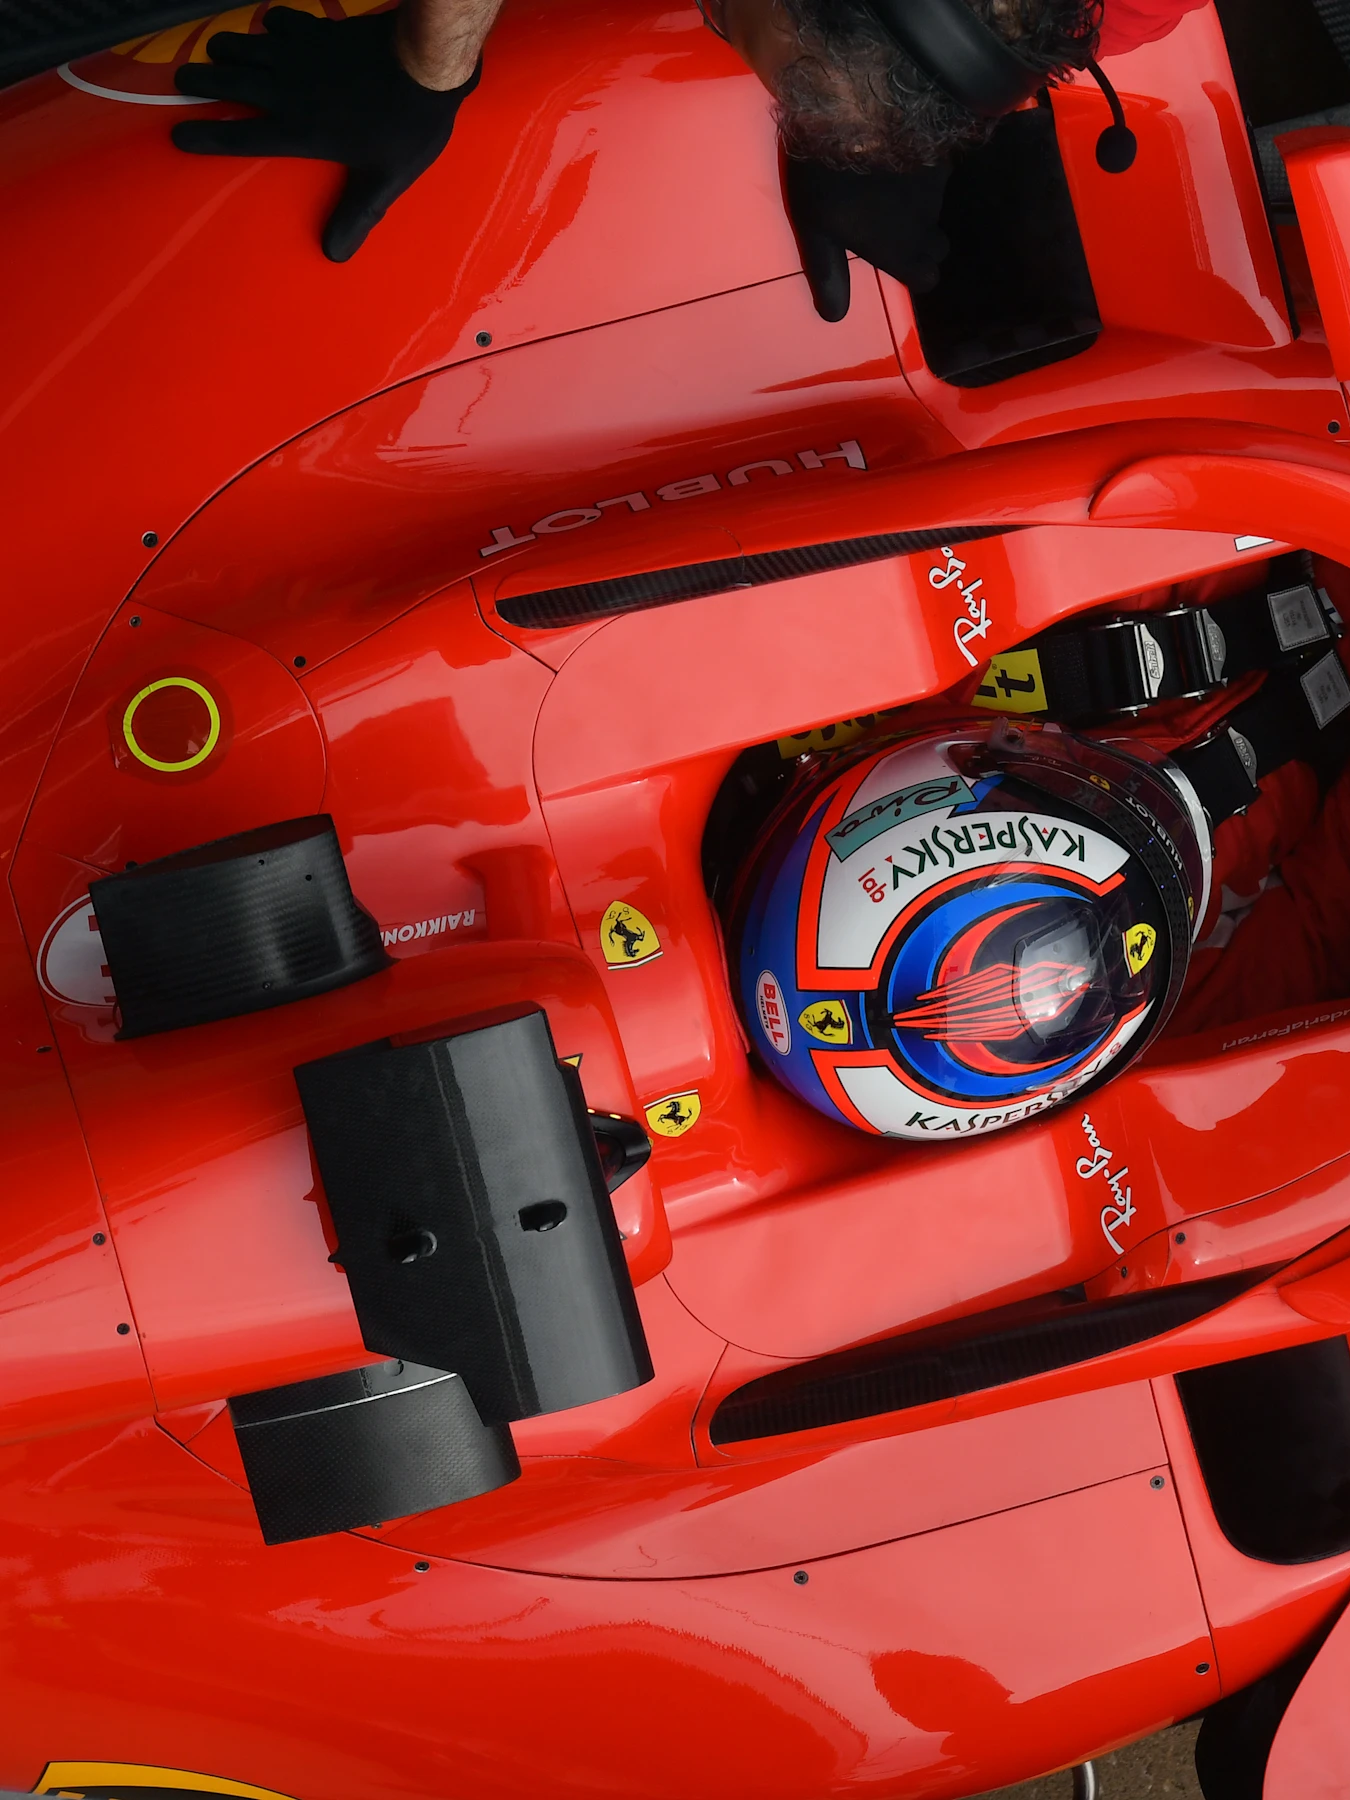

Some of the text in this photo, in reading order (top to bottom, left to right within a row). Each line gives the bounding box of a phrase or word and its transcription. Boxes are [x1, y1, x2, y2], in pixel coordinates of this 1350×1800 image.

[479, 439, 868, 559] HUBLOT
[928, 546, 993, 668] Ray-Ba
[831, 778, 962, 840] Riva
[1124, 796, 1184, 872] HUBLOT
[857, 815, 1087, 904] KASPERSKY lab
[380, 908, 476, 948] RAIKKON
[763, 983, 785, 1044] BELL
[1076, 1113, 1137, 1256] Ray-Ban
